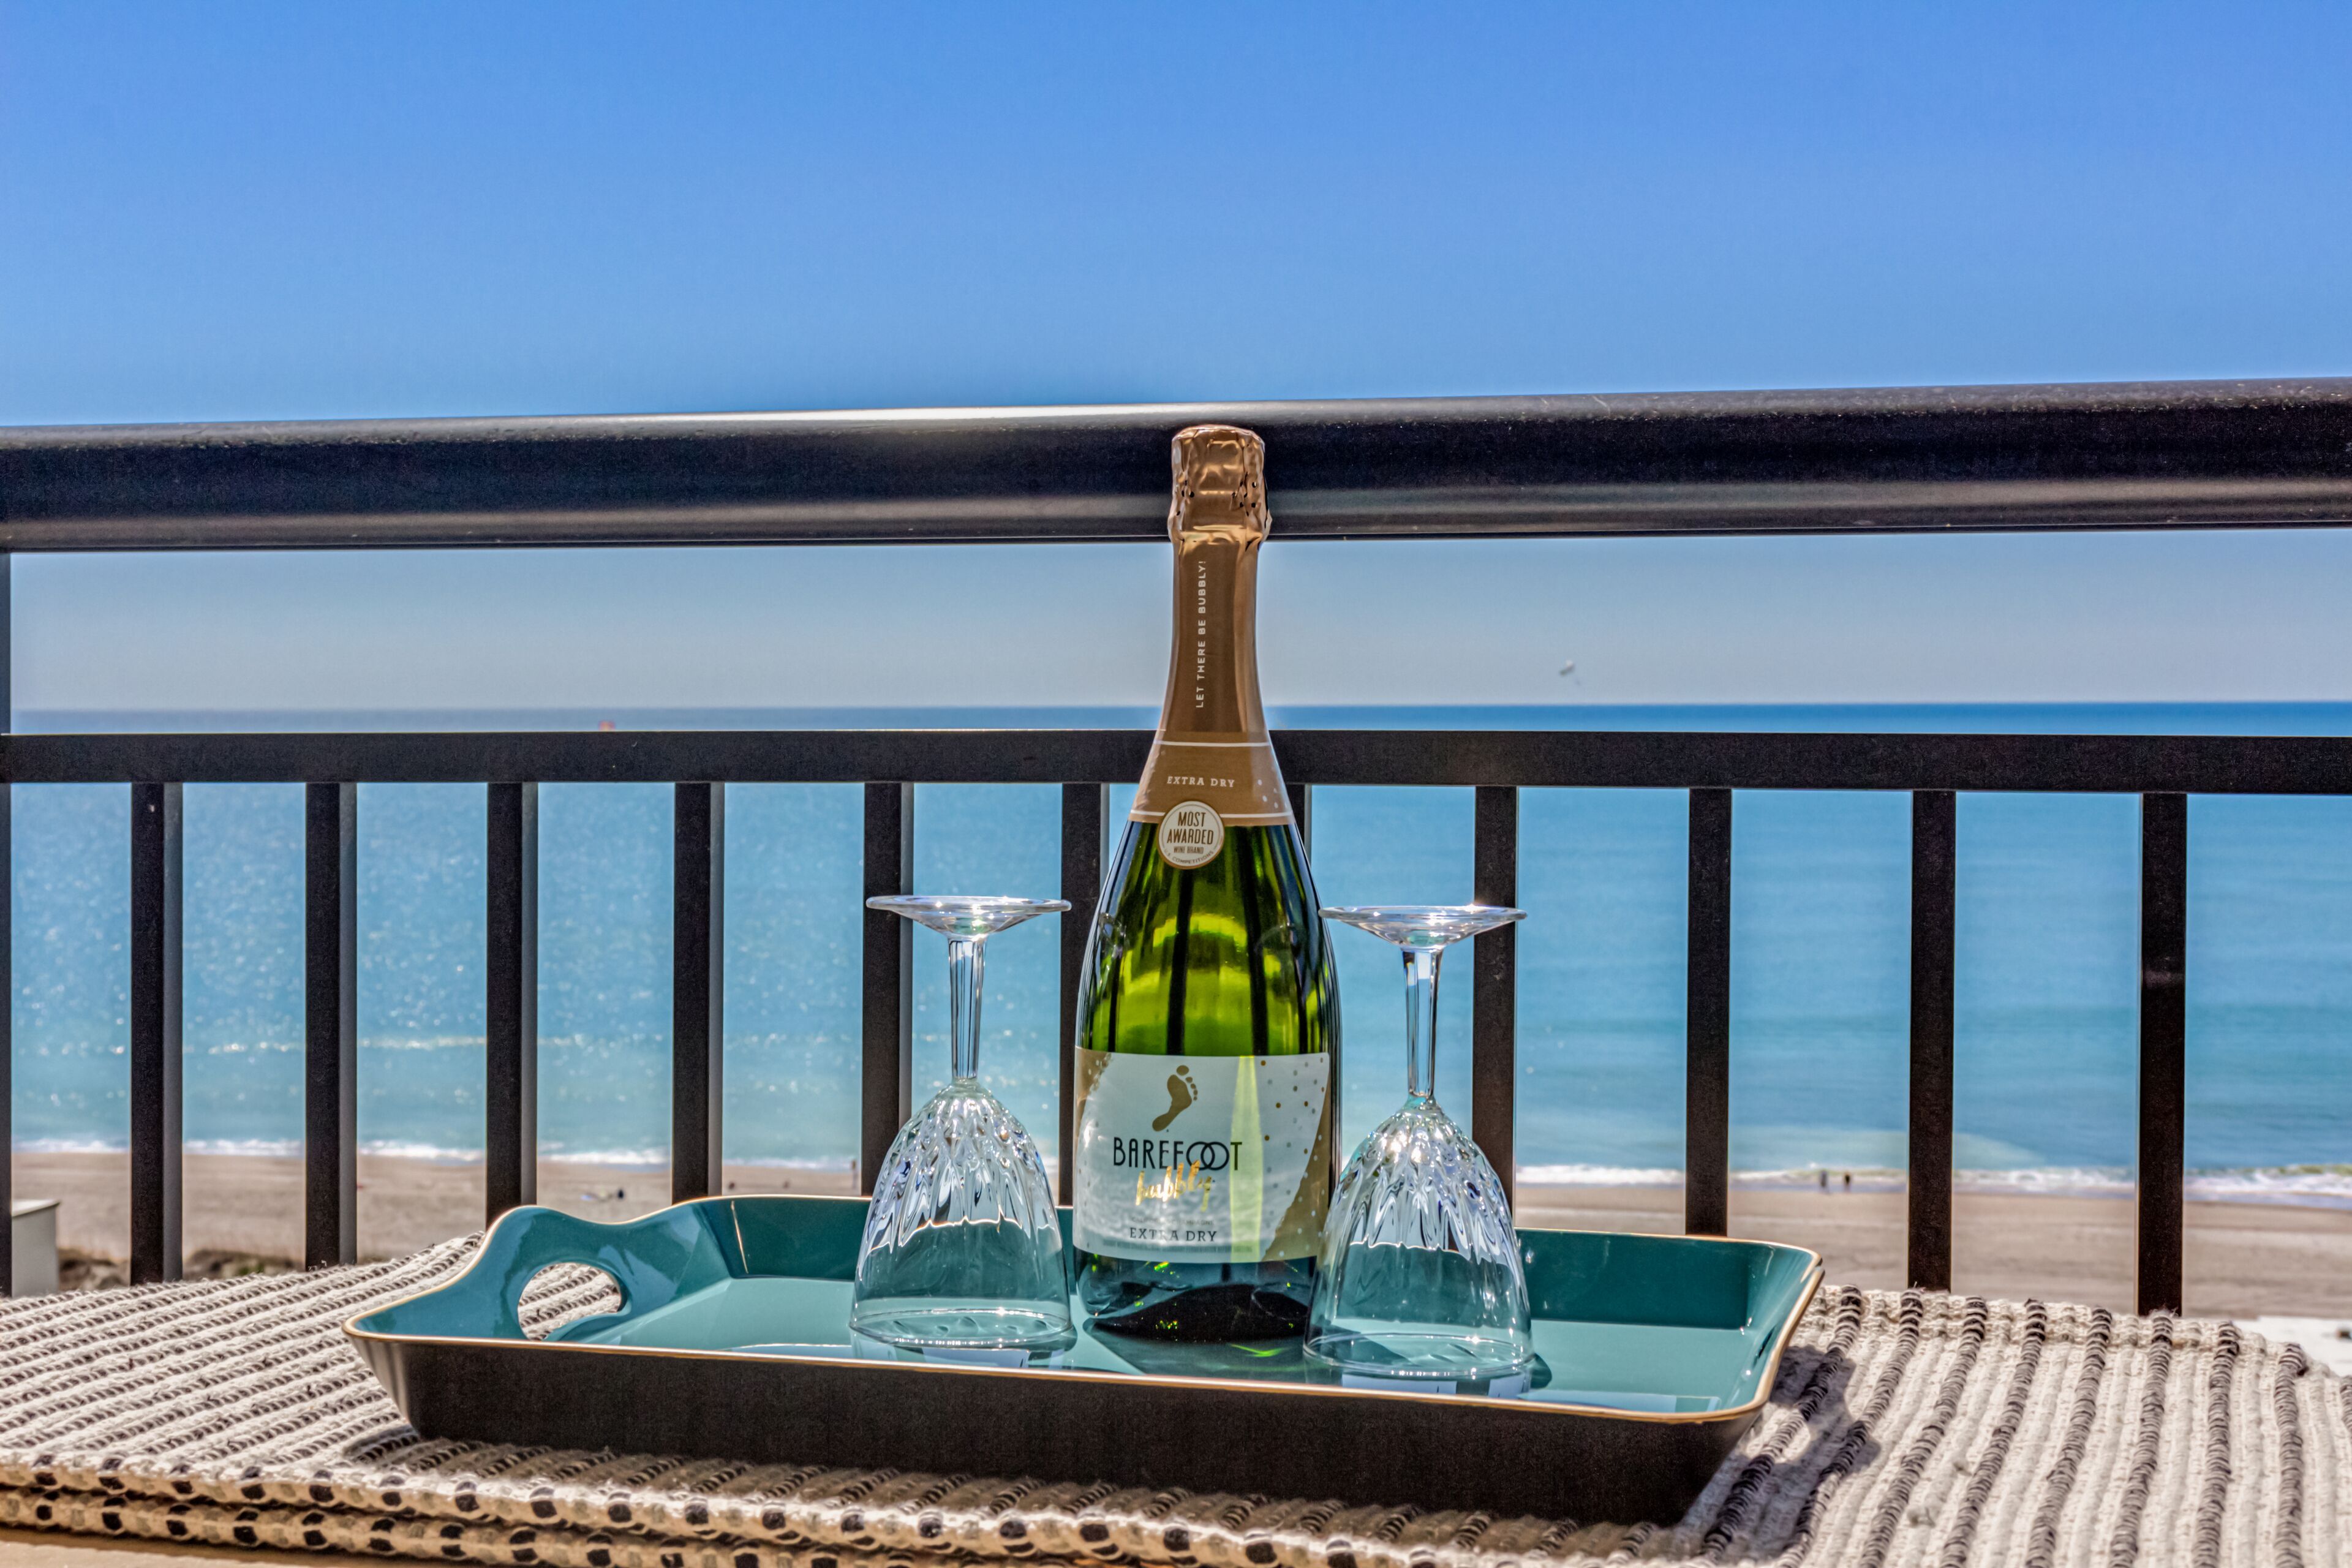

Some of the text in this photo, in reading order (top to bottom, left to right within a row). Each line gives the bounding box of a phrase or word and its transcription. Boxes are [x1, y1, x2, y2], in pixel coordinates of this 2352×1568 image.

[1198, 620, 1206, 635] BE
[1197, 641, 1205, 680] THERE
[1196, 687, 1204, 708] LET
[1167, 776, 1235, 788] EXTRA DRY
[1178, 812, 1206, 827] MOST
[1167, 829, 1214, 845] AWARDED
[1114, 1137, 1243, 1171] BAREFOOT
[1135, 1159, 1212, 1213] bubbly
[1129, 1227, 1218, 1242] EXTRA DRY
